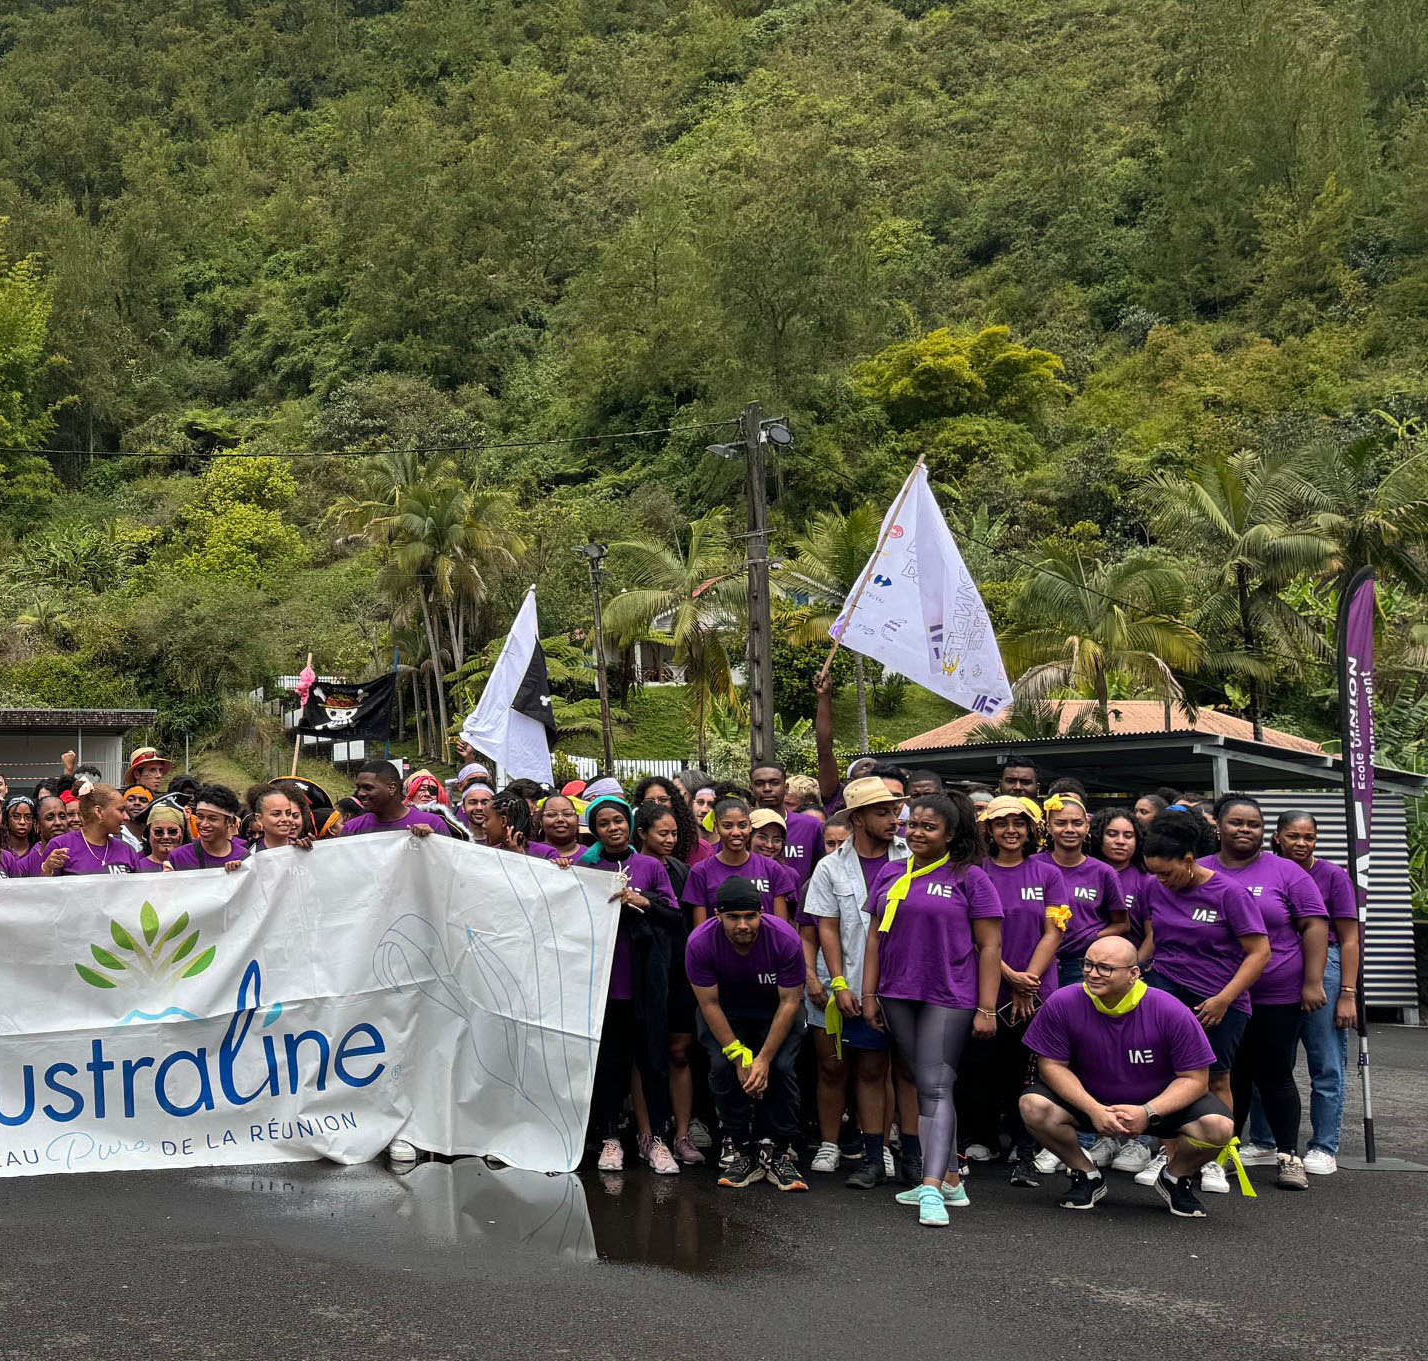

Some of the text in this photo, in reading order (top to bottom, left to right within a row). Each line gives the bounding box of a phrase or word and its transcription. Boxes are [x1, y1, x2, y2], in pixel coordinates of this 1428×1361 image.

[1356, 752, 1367, 790] Ecole
[784, 845, 804, 858] IAE
[926, 882, 953, 899] IAE
[1020, 886, 1044, 901] IAE
[1074, 886, 1097, 901] IAE
[1191, 908, 1218, 923] IAE
[757, 972, 778, 985] IAE
[1128, 1049, 1154, 1064] IAE
[45, 1131, 150, 1170] Pure
[161, 1138, 194, 1156] DE
[206, 1130, 237, 1149] LA
[250, 1110, 358, 1142] RÉUNION
